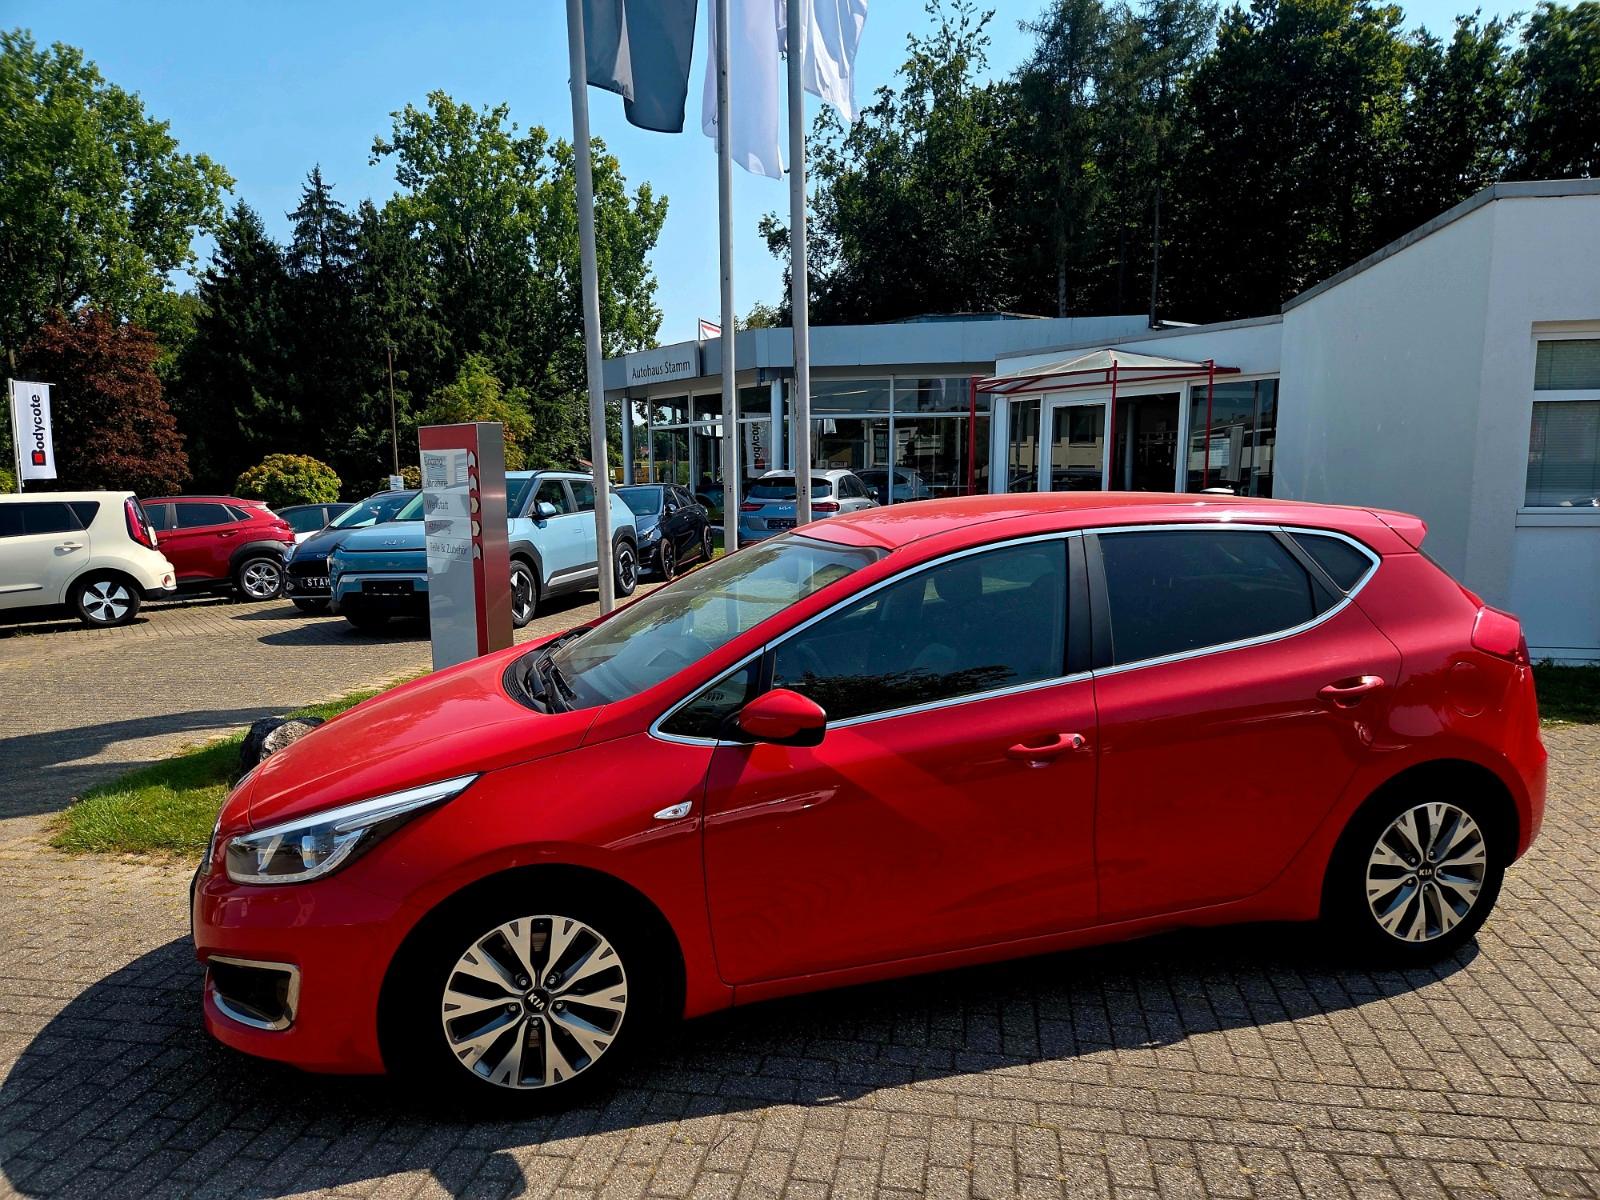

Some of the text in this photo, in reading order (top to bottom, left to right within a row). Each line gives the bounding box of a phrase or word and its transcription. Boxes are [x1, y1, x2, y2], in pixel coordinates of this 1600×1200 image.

[632, 360, 691, 379] Autohaus Stamm
[30, 394, 46, 466] Bodycote
[441, 543, 448, 553] &
[1419, 868, 1432, 876] KIA
[528, 993, 545, 1010] KIA
